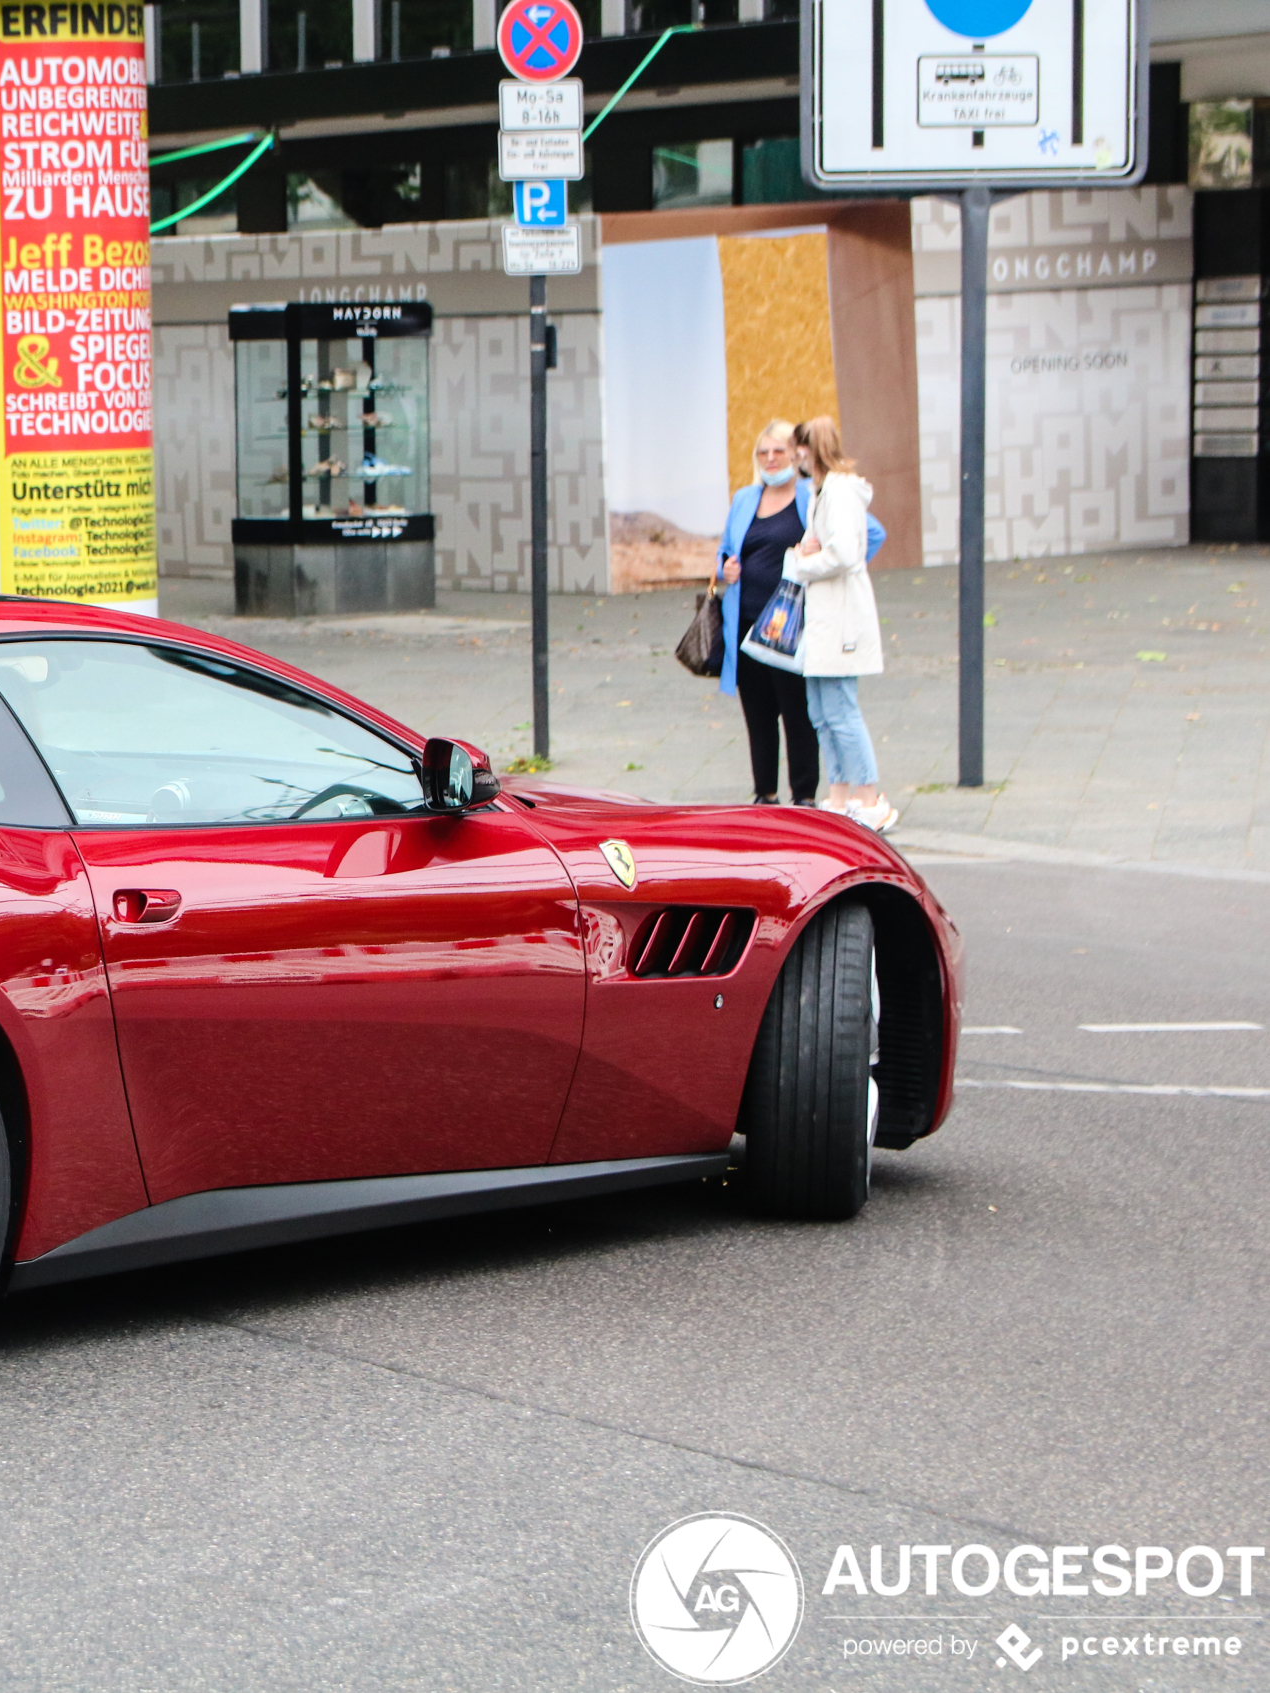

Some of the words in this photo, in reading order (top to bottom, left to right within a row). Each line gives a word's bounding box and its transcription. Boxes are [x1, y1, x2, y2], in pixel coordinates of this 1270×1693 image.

[1, 3, 145, 36] ERFINDER
[517, 89, 563, 104] Mo-Sa
[922, 89, 1033, 104] Krankenfahrzeuge
[2, 111, 139, 138] REICHWEITE
[522, 109, 560, 124] 8-16h
[953, 108, 979, 120] TAXI
[984, 107, 1005, 120] frei
[3, 140, 112, 170] STROM
[3, 171, 93, 188] Milliarden
[3, 187, 53, 220] ZU
[66, 184, 150, 218] HAUSE
[522, 181, 551, 222] P
[4, 233, 72, 270] Jeff
[83, 234, 151, 269] Bezos
[992, 250, 1158, 283] ONGCHAMP
[4, 268, 92, 293] MELDE
[5, 290, 129, 312] WASHINGTON
[5, 308, 151, 334] BILD-ZEITUNG
[333, 306, 403, 320] MAYDORN
[13, 335, 62, 388] &
[1010, 355, 1079, 374] OPENING
[1084, 351, 1129, 371] SOON
[78, 361, 151, 391] FOCUS
[5, 391, 98, 412] SCHREIBT
[103, 389, 136, 410] VON
[11, 458, 27, 469] AN
[30, 458, 58, 469] ALLE
[62, 455, 123, 467] MENSCHEN
[12, 479, 122, 500] Unterstütz
[12, 516, 66, 531] Twitter:
[13, 532, 83, 546] Instagram:
[13, 544, 82, 559] Facebook:
[48, 571, 63, 583] für
